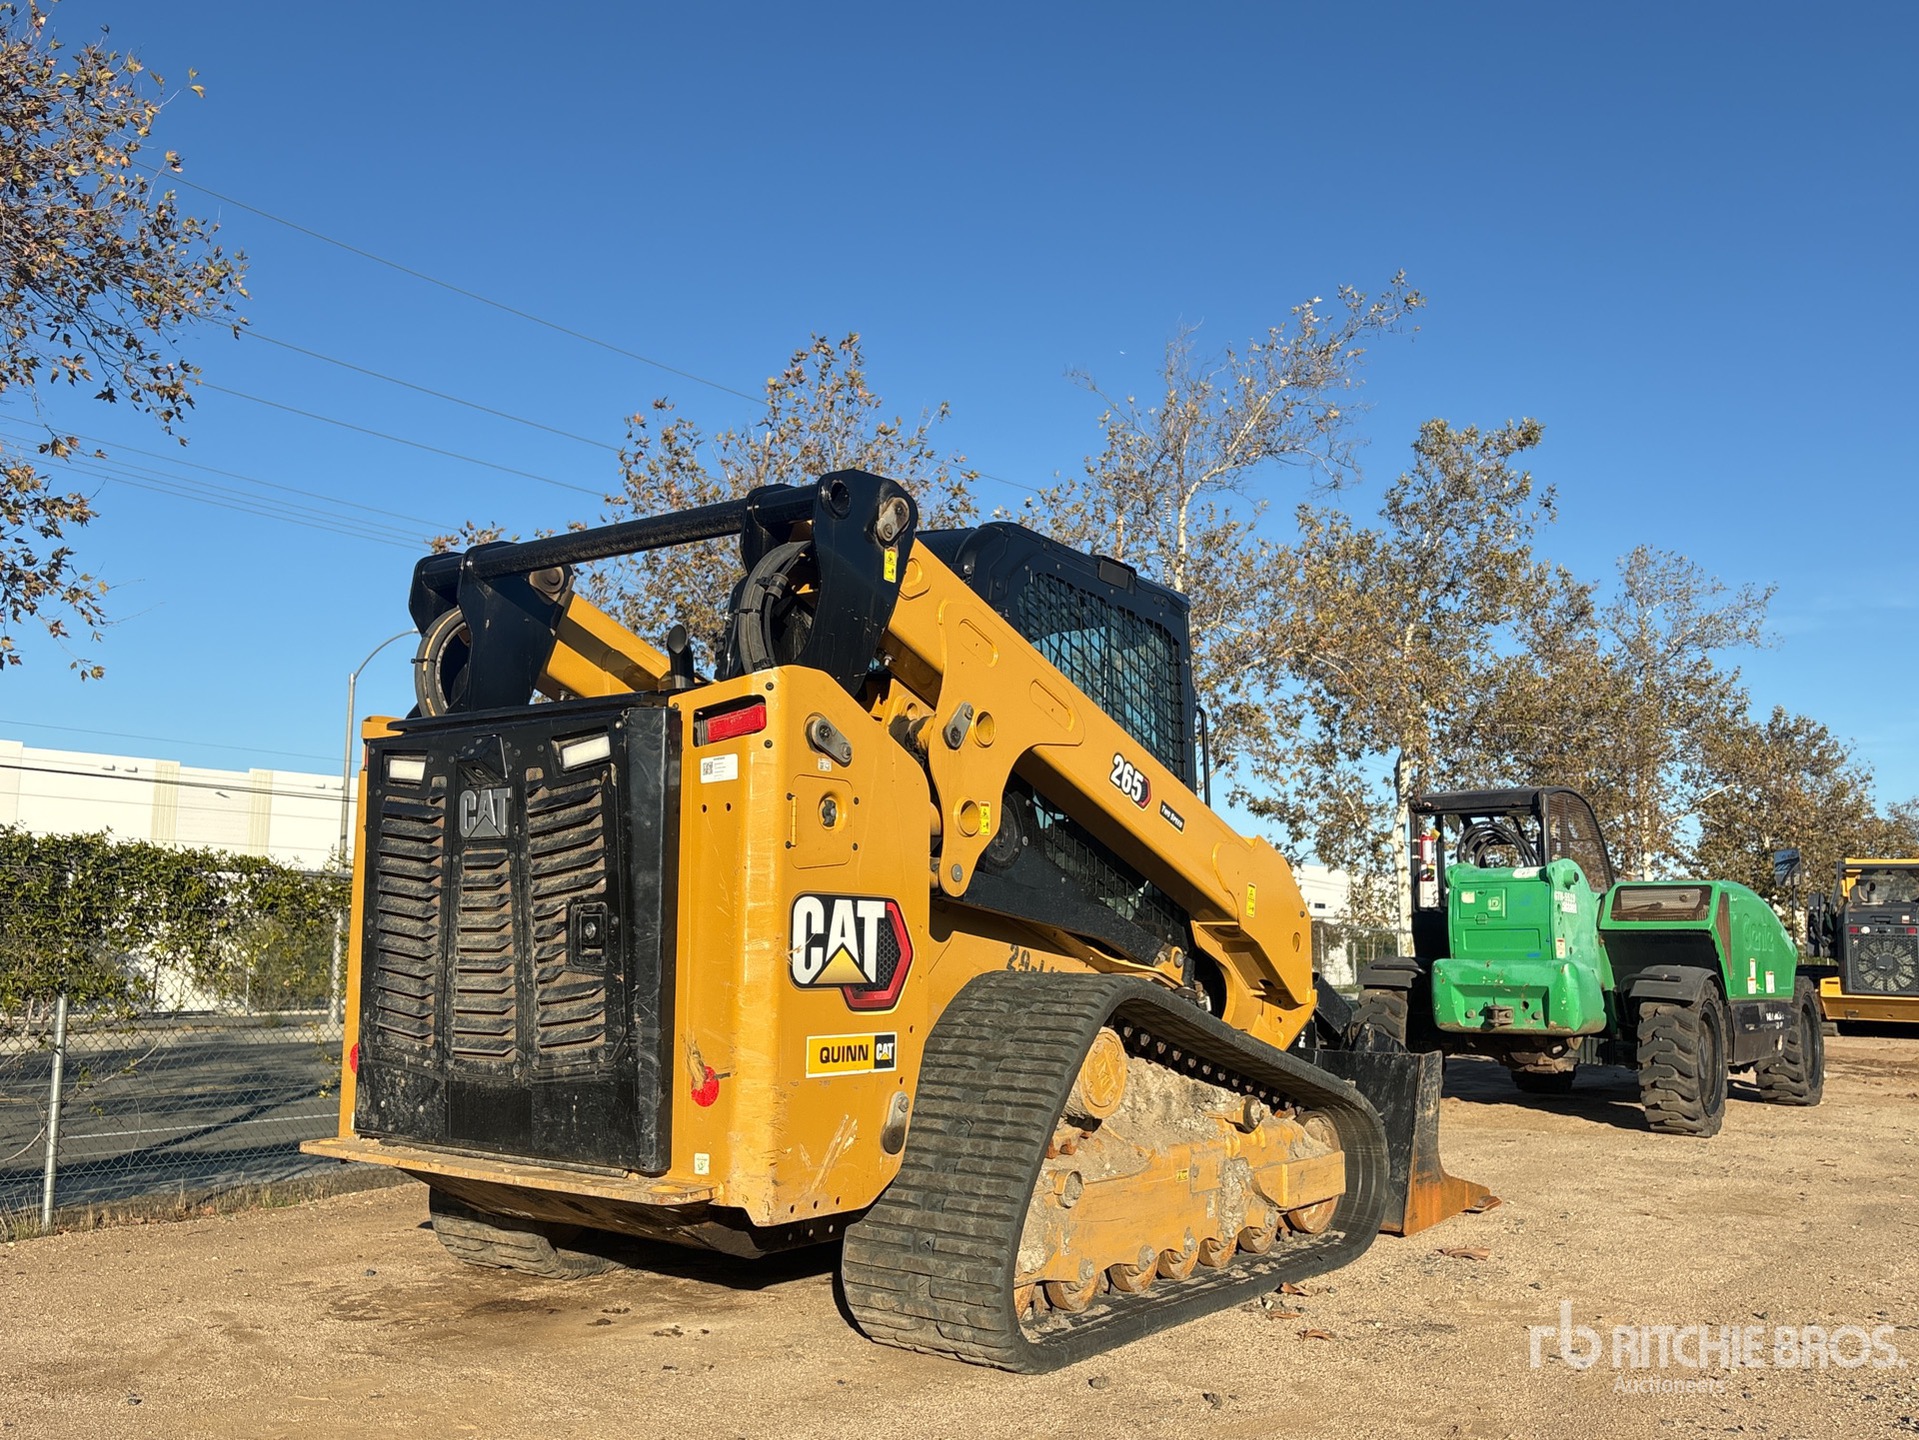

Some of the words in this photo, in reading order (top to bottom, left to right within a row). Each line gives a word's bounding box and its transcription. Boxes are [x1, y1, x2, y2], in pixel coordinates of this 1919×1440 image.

[1109, 753, 1145, 803] 265
[459, 787, 512, 838] CAT
[792, 895, 886, 985] CAT
[819, 1044, 869, 1064] QUINN
[875, 1042, 894, 1061] CAT
